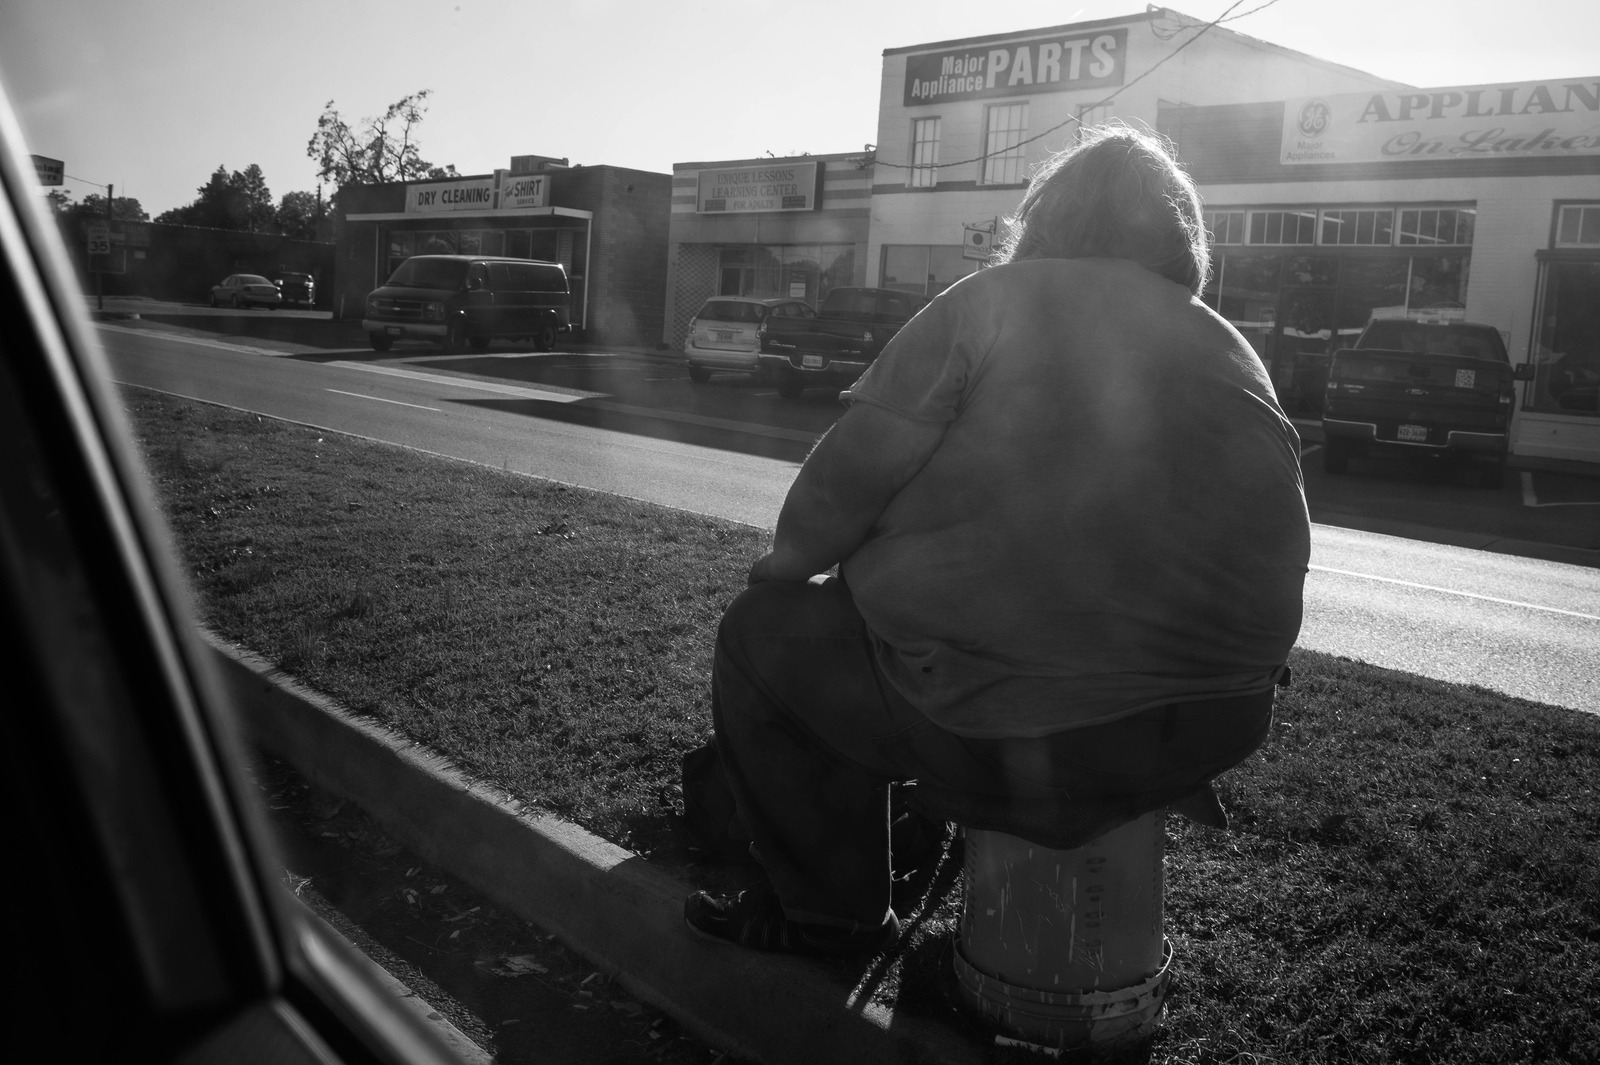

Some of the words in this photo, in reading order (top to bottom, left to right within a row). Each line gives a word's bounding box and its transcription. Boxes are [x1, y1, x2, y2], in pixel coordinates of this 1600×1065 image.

[941, 54, 985, 76] Major
[986, 36, 1116, 88] PARTS
[911, 75, 983, 99] Appliance
[1356, 82, 1600, 123] APPLIAN
[1297, 141, 1324, 151] Major
[1380, 131, 1444, 156] On
[1286, 151, 1335, 161] Appliances
[718, 173, 749, 185] UNIQUE
[752, 169, 793, 183] LESSONS
[418, 191, 436, 205] DRY
[442, 188, 490, 203] CLEANING
[515, 179, 542, 197] SHIRT
[712, 186, 758, 199] LEARNING
[760, 185, 797, 197] CENTER
[733, 201, 747, 209] FOR
[749, 201, 774, 209] ADULTS
[90, 241, 108, 251] 35
